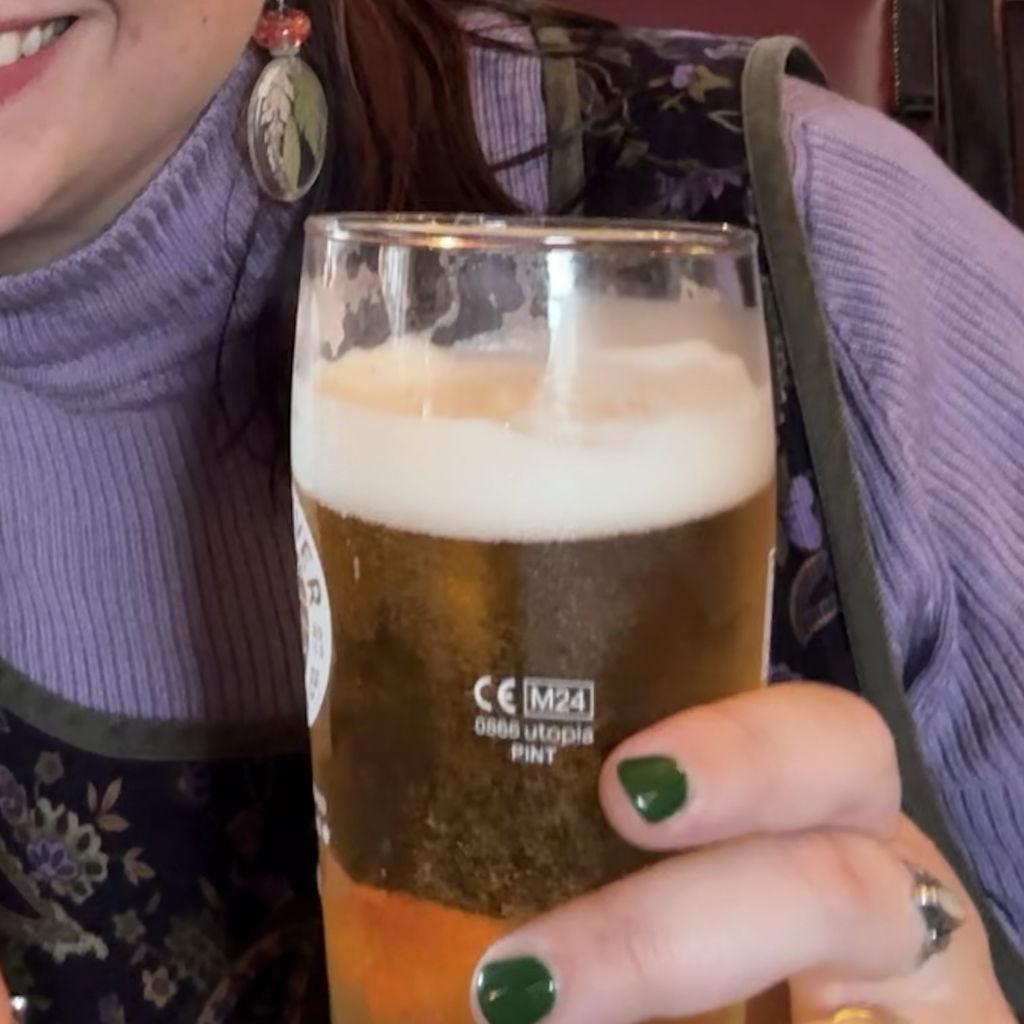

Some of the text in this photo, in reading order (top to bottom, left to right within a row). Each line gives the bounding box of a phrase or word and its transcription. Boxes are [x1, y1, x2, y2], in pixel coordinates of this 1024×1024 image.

[474, 674, 585, 715] CE M24
[524, 721, 594, 747] utopia
[511, 741, 557, 765] PINT
